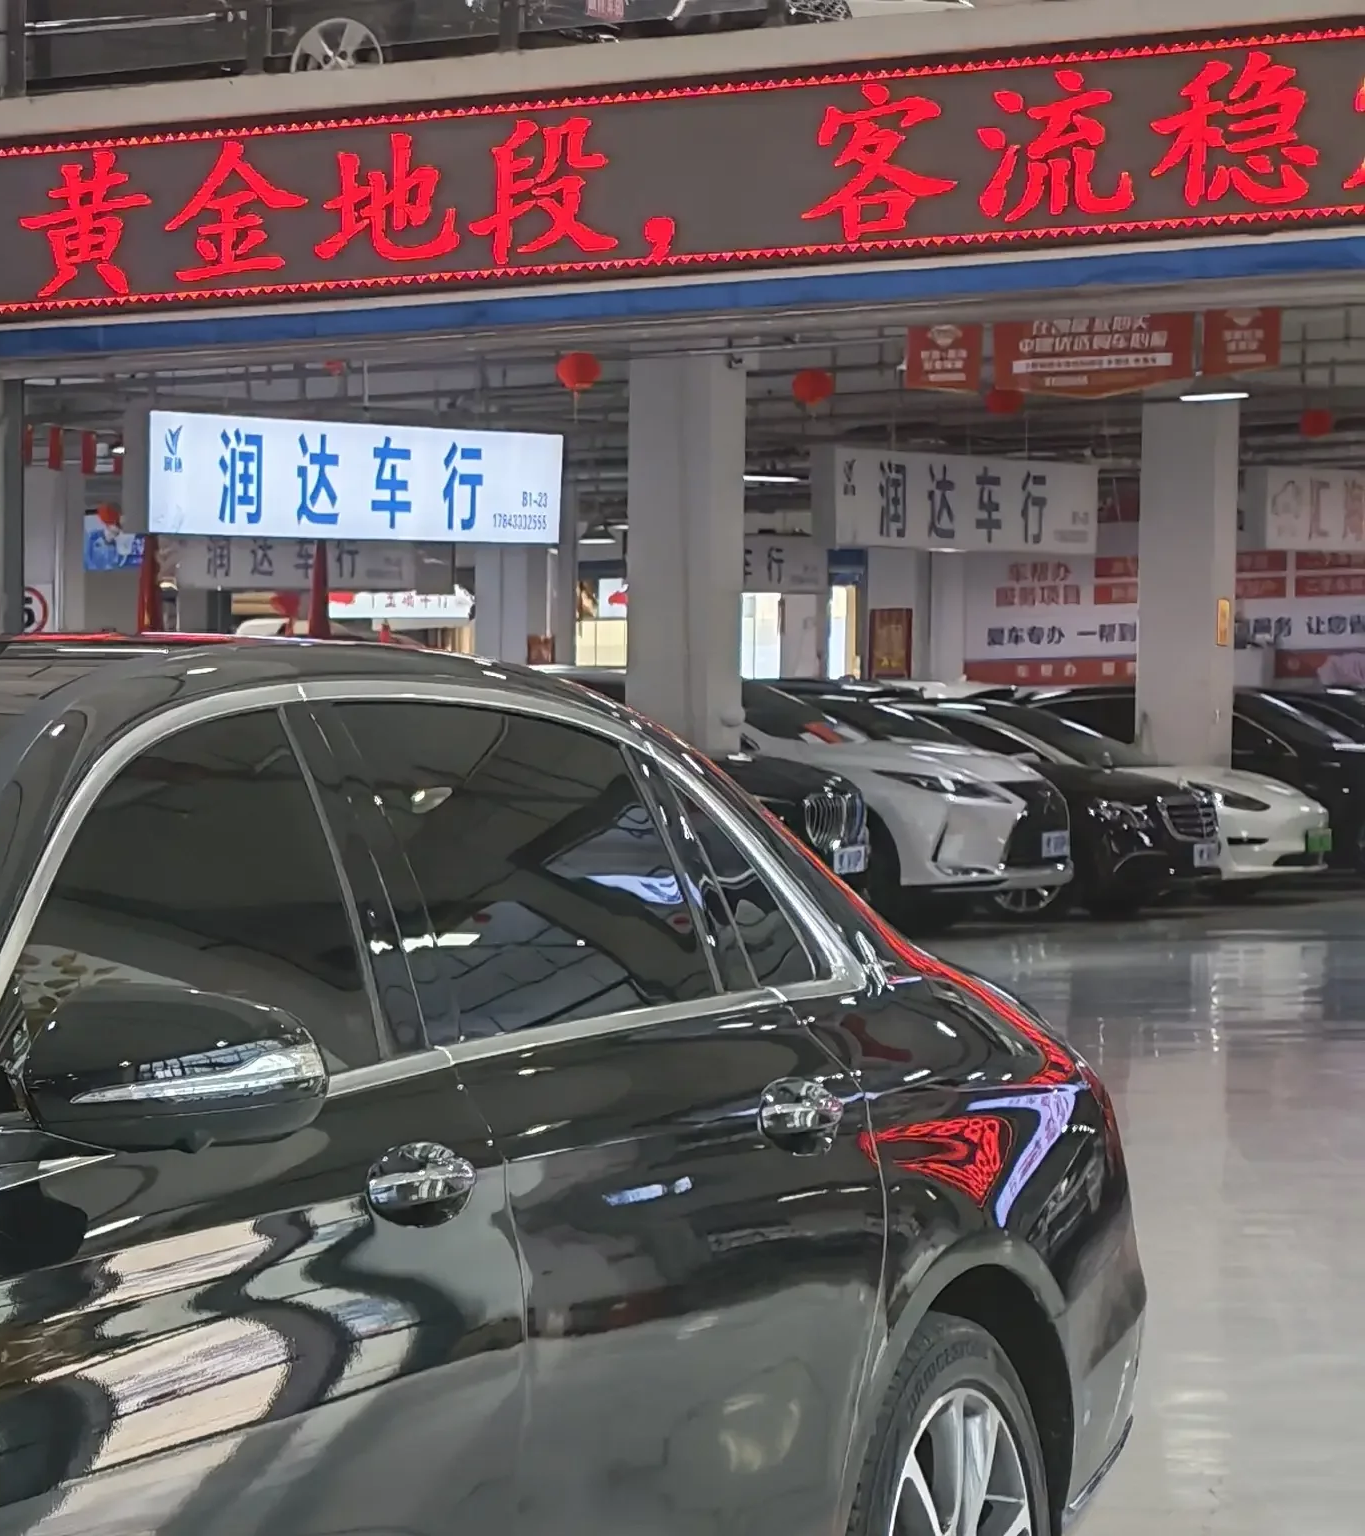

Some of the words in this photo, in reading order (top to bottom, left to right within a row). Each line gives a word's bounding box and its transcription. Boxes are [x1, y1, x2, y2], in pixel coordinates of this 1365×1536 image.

[218, 428, 484, 531] 润达车行
[521, 490, 549, 509] B1-23
[878, 459, 1048, 545] 润达车行
